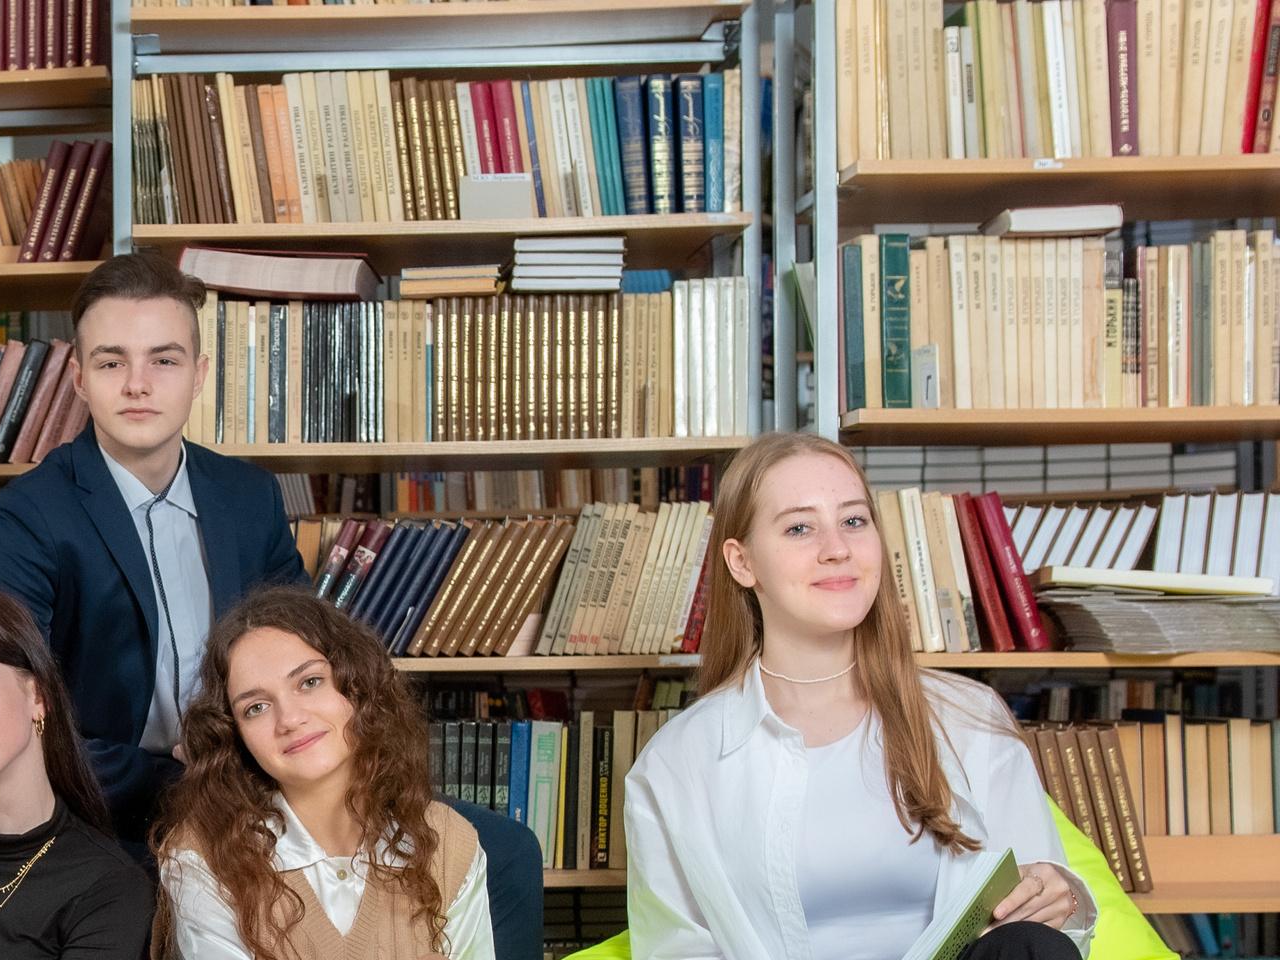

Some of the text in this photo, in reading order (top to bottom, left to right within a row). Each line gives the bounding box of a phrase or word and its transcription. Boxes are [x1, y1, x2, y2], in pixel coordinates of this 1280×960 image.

[1117, 30, 1129, 52] ДУШИ
[292, 106, 310, 196] ВАЛЕНТИН РАСПУТИН
[308, 109, 325, 198] ВАЛЕНТИН РАСПУТИН
[323, 104, 341, 195] ВАЛЕНТИН РАСПУТИН
[338, 104, 356, 195] ВАЛЕНТИН РАСПУТИН
[353, 109, 369, 198] ВАЛЕНТИН РАСПУТИН
[367, 103, 384, 192] ВАЛЕНТИН РАСПУТИН
[380, 106, 396, 195] ВАЛЕНТИН РАСПУТИН
[226, 319, 234, 366] ПОЕДИНОК
[238, 323, 246, 369] ПОЕДИНОК
[271, 311, 281, 351] Рассказы
[610, 542, 625, 569] ИЗБРАННАЯ
[618, 519, 632, 540] ЛИРИКА
[894, 563, 908, 599] Горький
[597, 776, 610, 849] ВИКТОР ДОЦЕНКО
